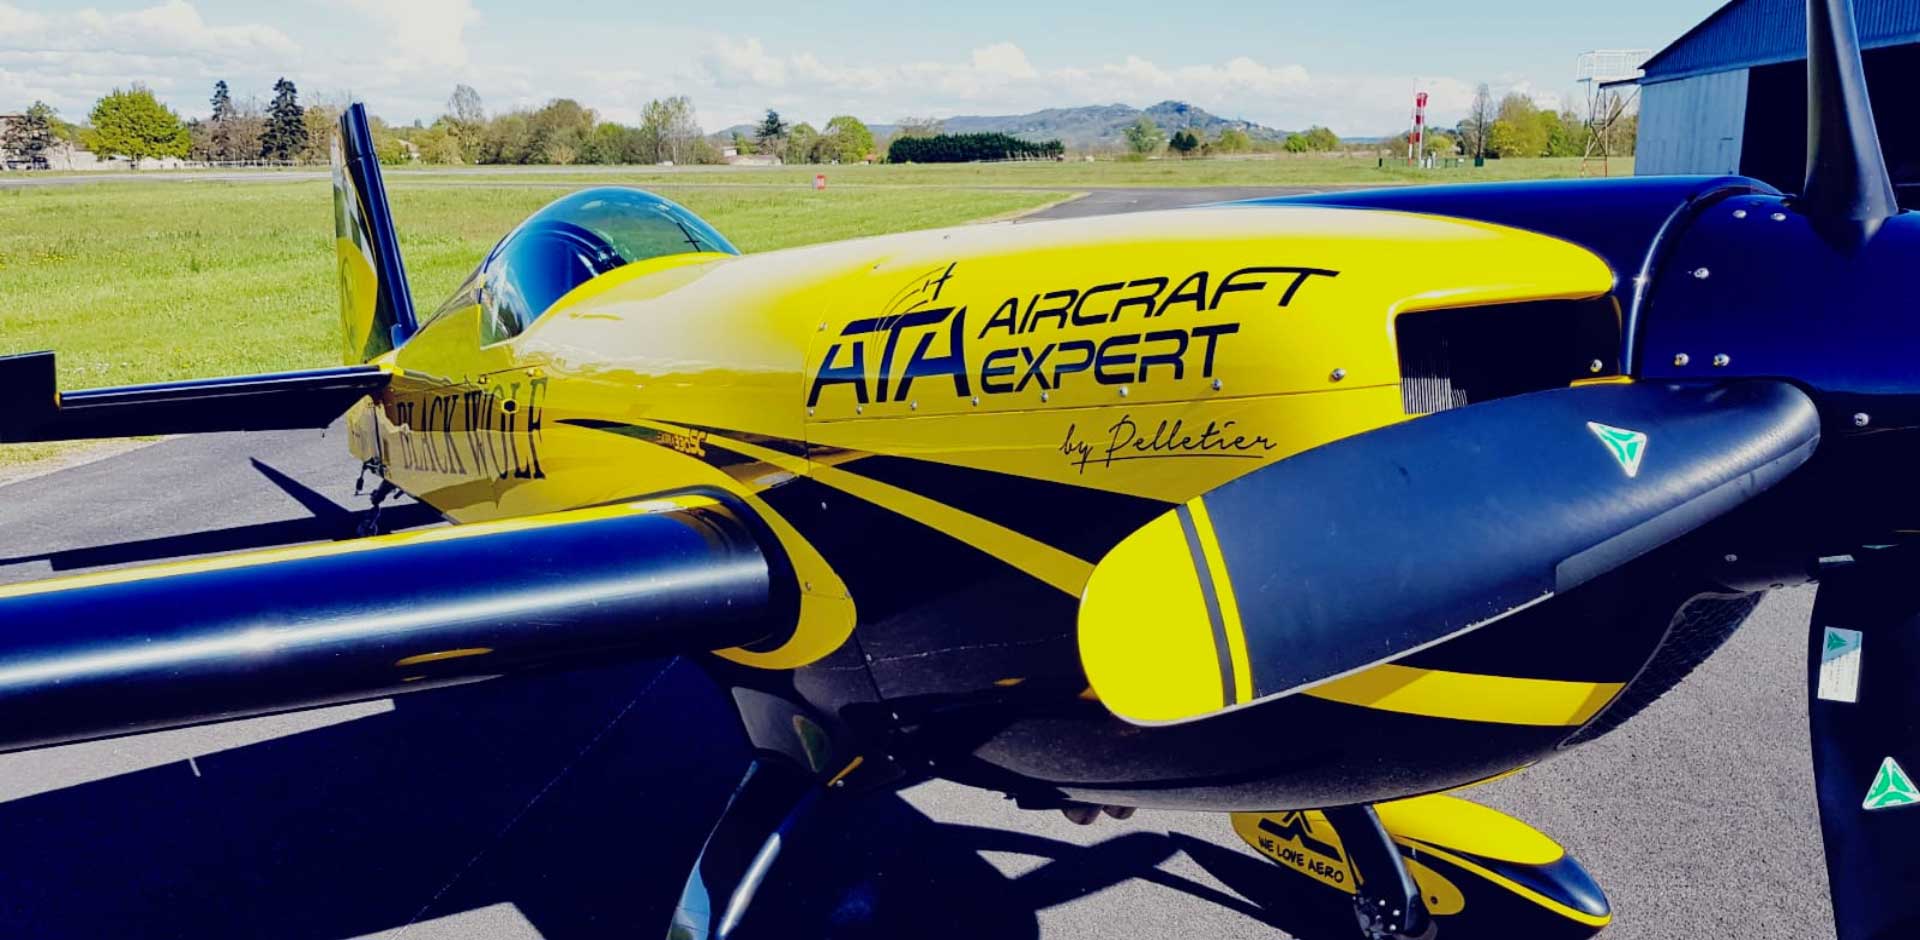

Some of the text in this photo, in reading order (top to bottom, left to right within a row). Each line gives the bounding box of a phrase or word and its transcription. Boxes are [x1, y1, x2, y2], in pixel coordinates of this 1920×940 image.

[978, 266, 1341, 339] AIRCRAFT
[806, 305, 973, 408] ATA
[979, 323, 1240, 395] EXPERT
[396, 377, 548, 480] BLACK WOLF
[1059, 414, 1277, 475] by Pelletier
[1258, 835, 1345, 884] WE LOVE AERO
